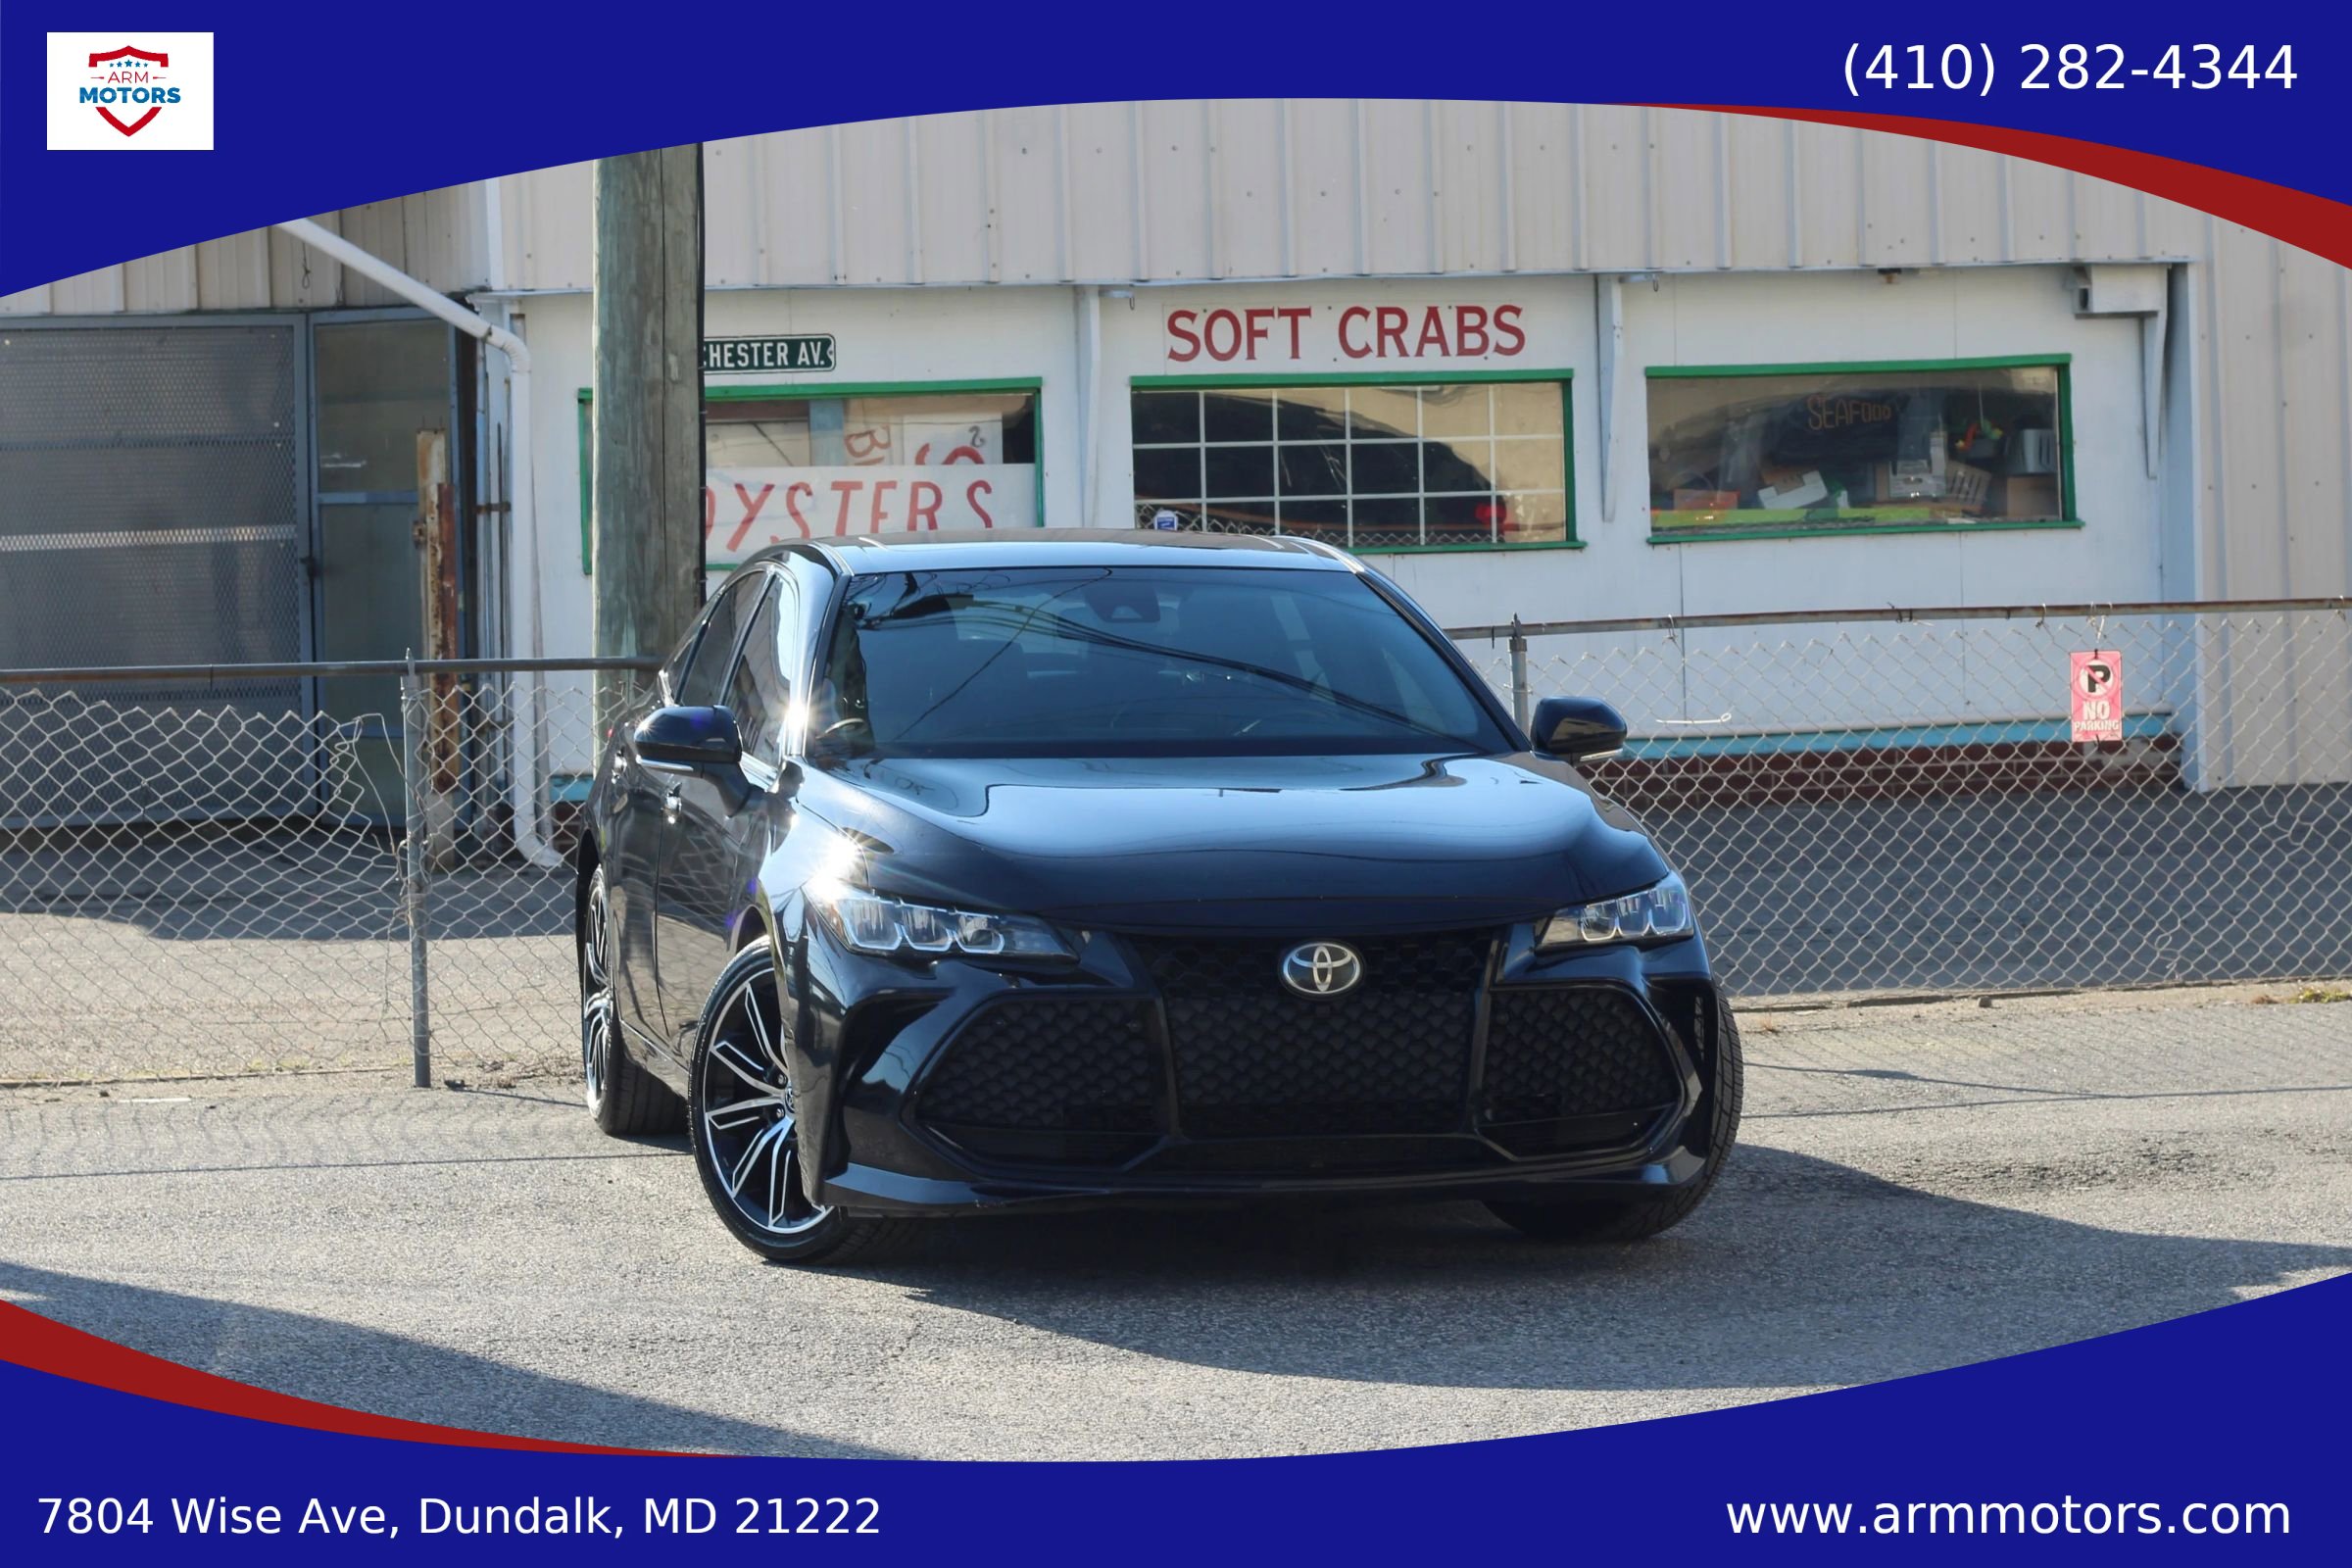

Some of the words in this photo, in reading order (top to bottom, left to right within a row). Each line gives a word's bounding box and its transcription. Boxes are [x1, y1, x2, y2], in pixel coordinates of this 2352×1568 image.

[1167, 308, 1312, 363] SOFT
[1339, 304, 1526, 359] CRABS
[704, 341, 789, 368] HESTER
[797, 341, 825, 367] AV.
[2083, 701, 2110, 719] NO
[2075, 720, 2119, 731] PARKING
